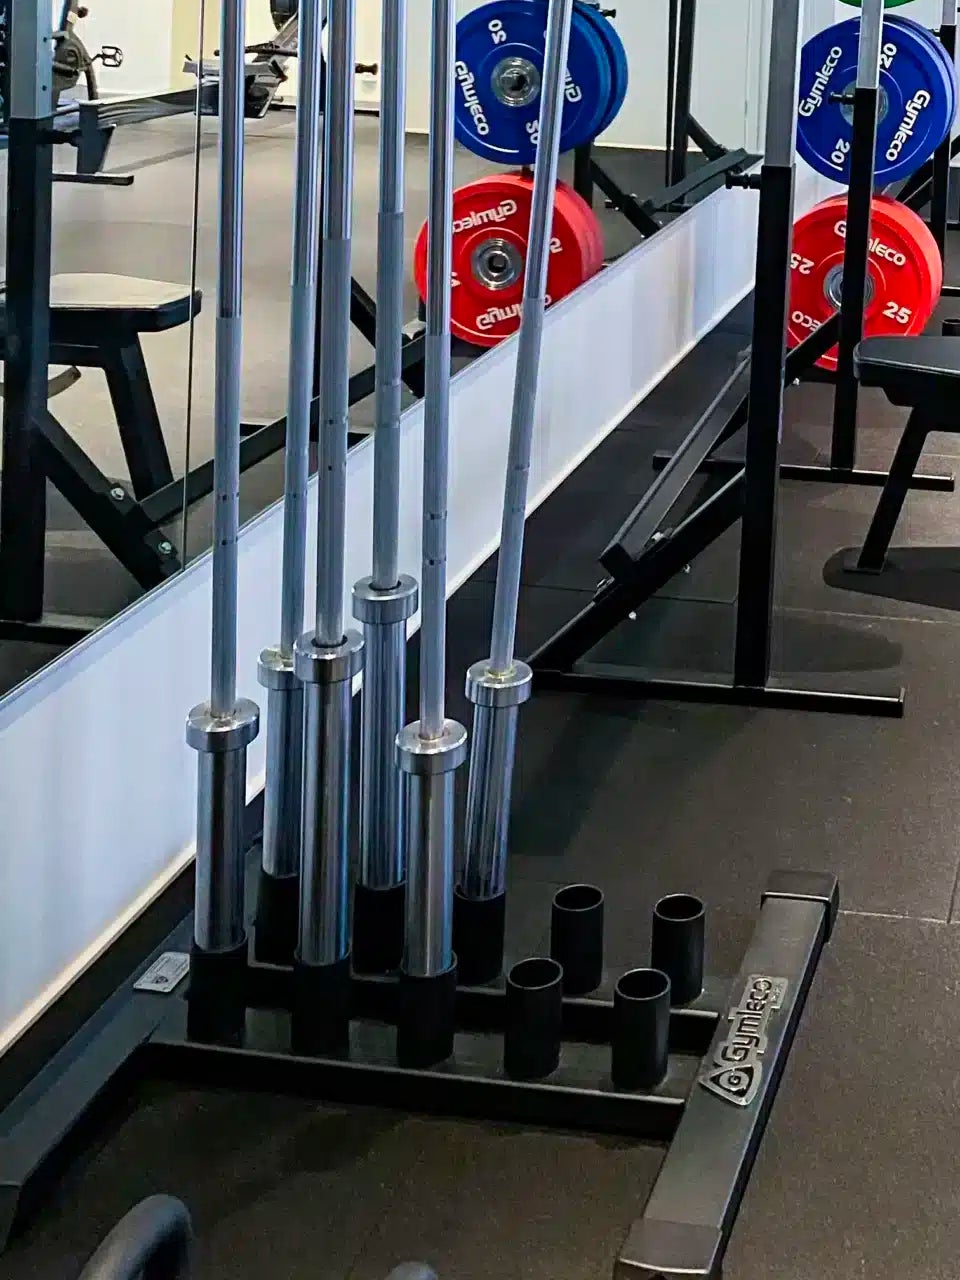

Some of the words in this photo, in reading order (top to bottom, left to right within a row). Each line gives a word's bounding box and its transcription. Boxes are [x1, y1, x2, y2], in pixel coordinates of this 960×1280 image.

[879, 43, 897, 69] 20
[798, 46, 842, 117] Gymleco
[885, 90, 931, 161] Gymleco
[831, 138, 851, 164] 20
[834, 220, 906, 266] Gleco
[882, 302, 912, 324] 25
[721, 979, 772, 1062] Gymleco
